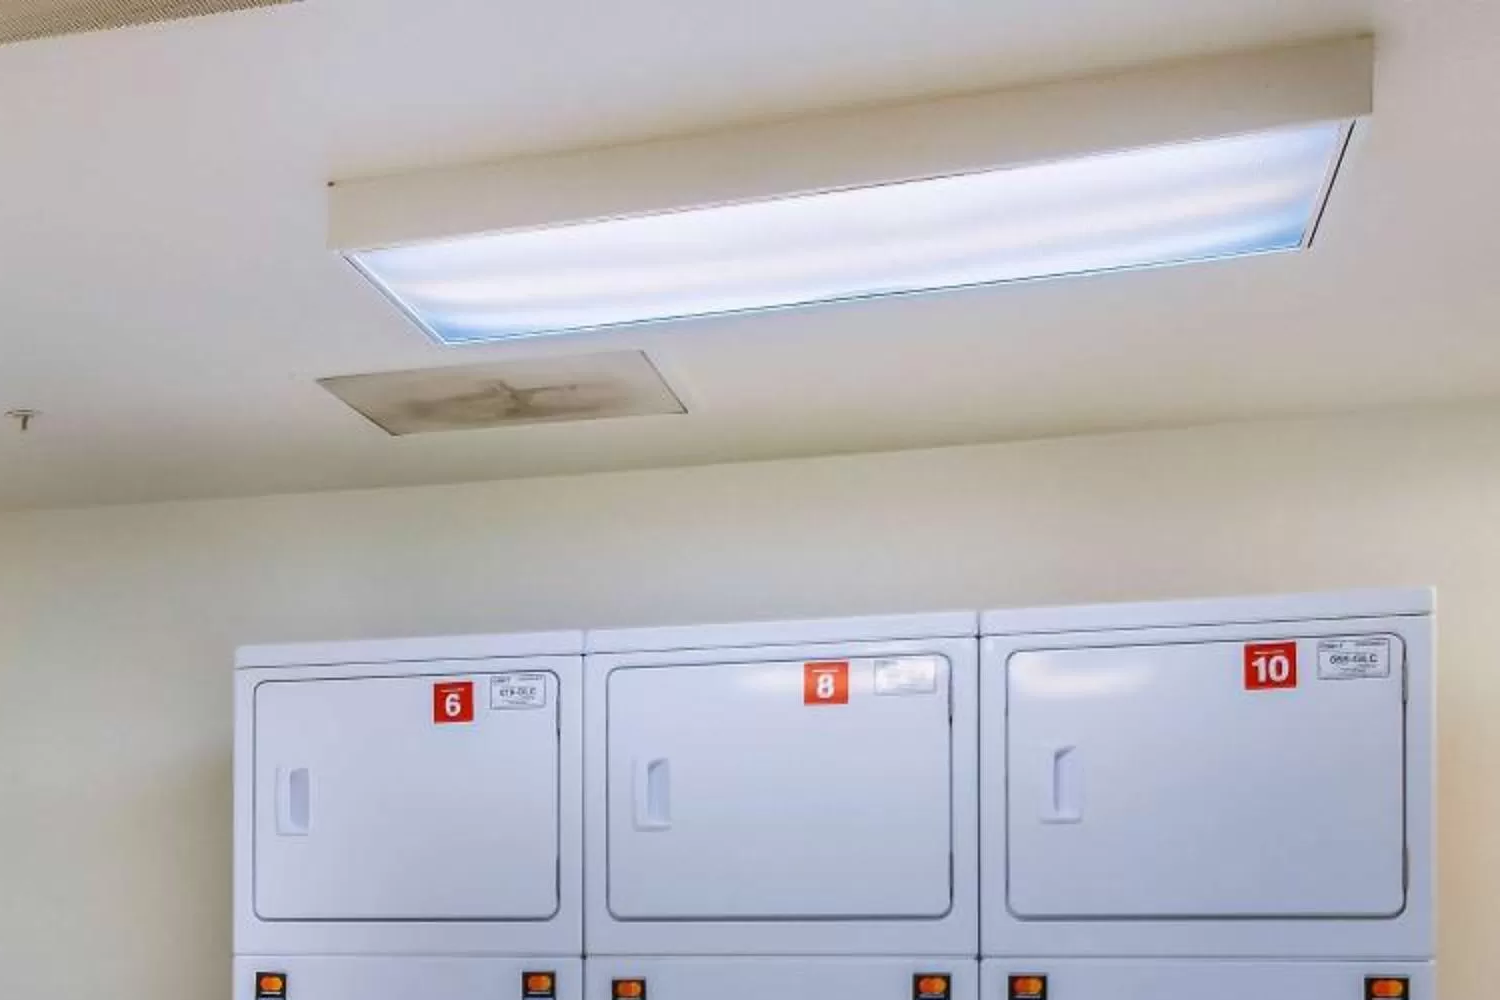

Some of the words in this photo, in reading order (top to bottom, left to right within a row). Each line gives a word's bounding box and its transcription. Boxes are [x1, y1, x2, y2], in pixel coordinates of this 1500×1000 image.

[1252, 655, 1290, 683] 10
[816, 673, 835, 699] 8
[445, 693, 461, 717] 6
